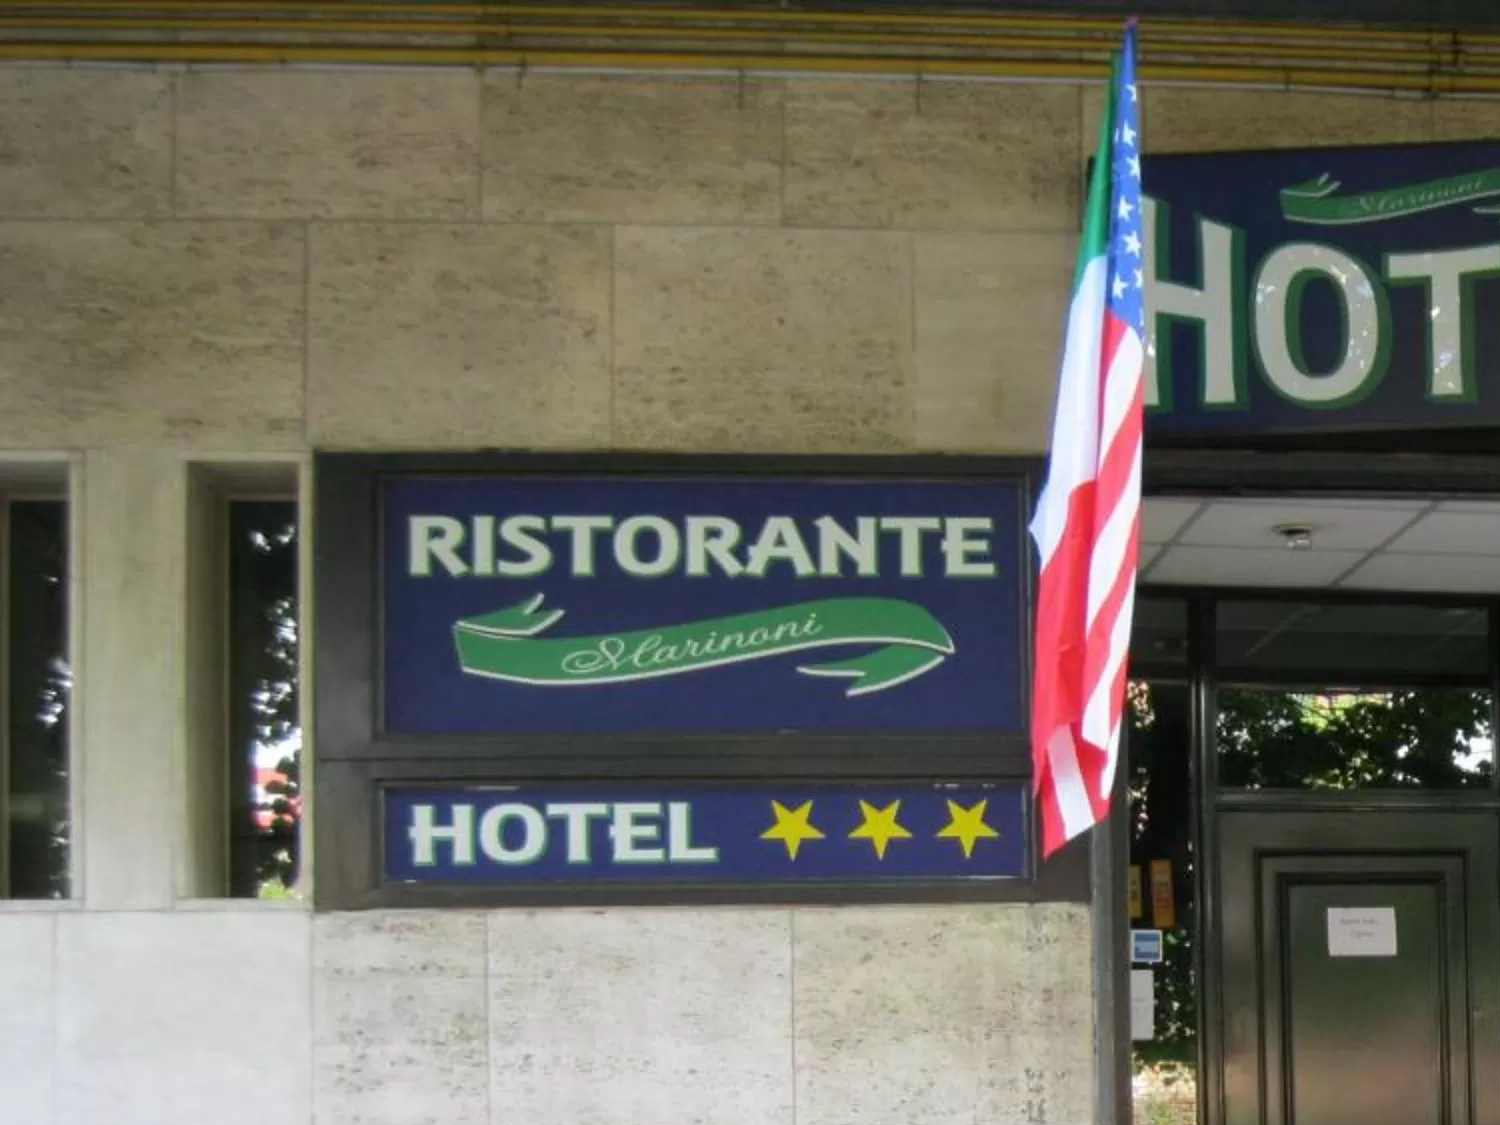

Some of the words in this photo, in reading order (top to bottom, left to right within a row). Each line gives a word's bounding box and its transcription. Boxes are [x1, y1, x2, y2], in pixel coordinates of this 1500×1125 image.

[408, 514, 996, 577] RISTORANTE
[561, 611, 823, 674] Marinoni
[408, 800, 718, 866] HOTEL
